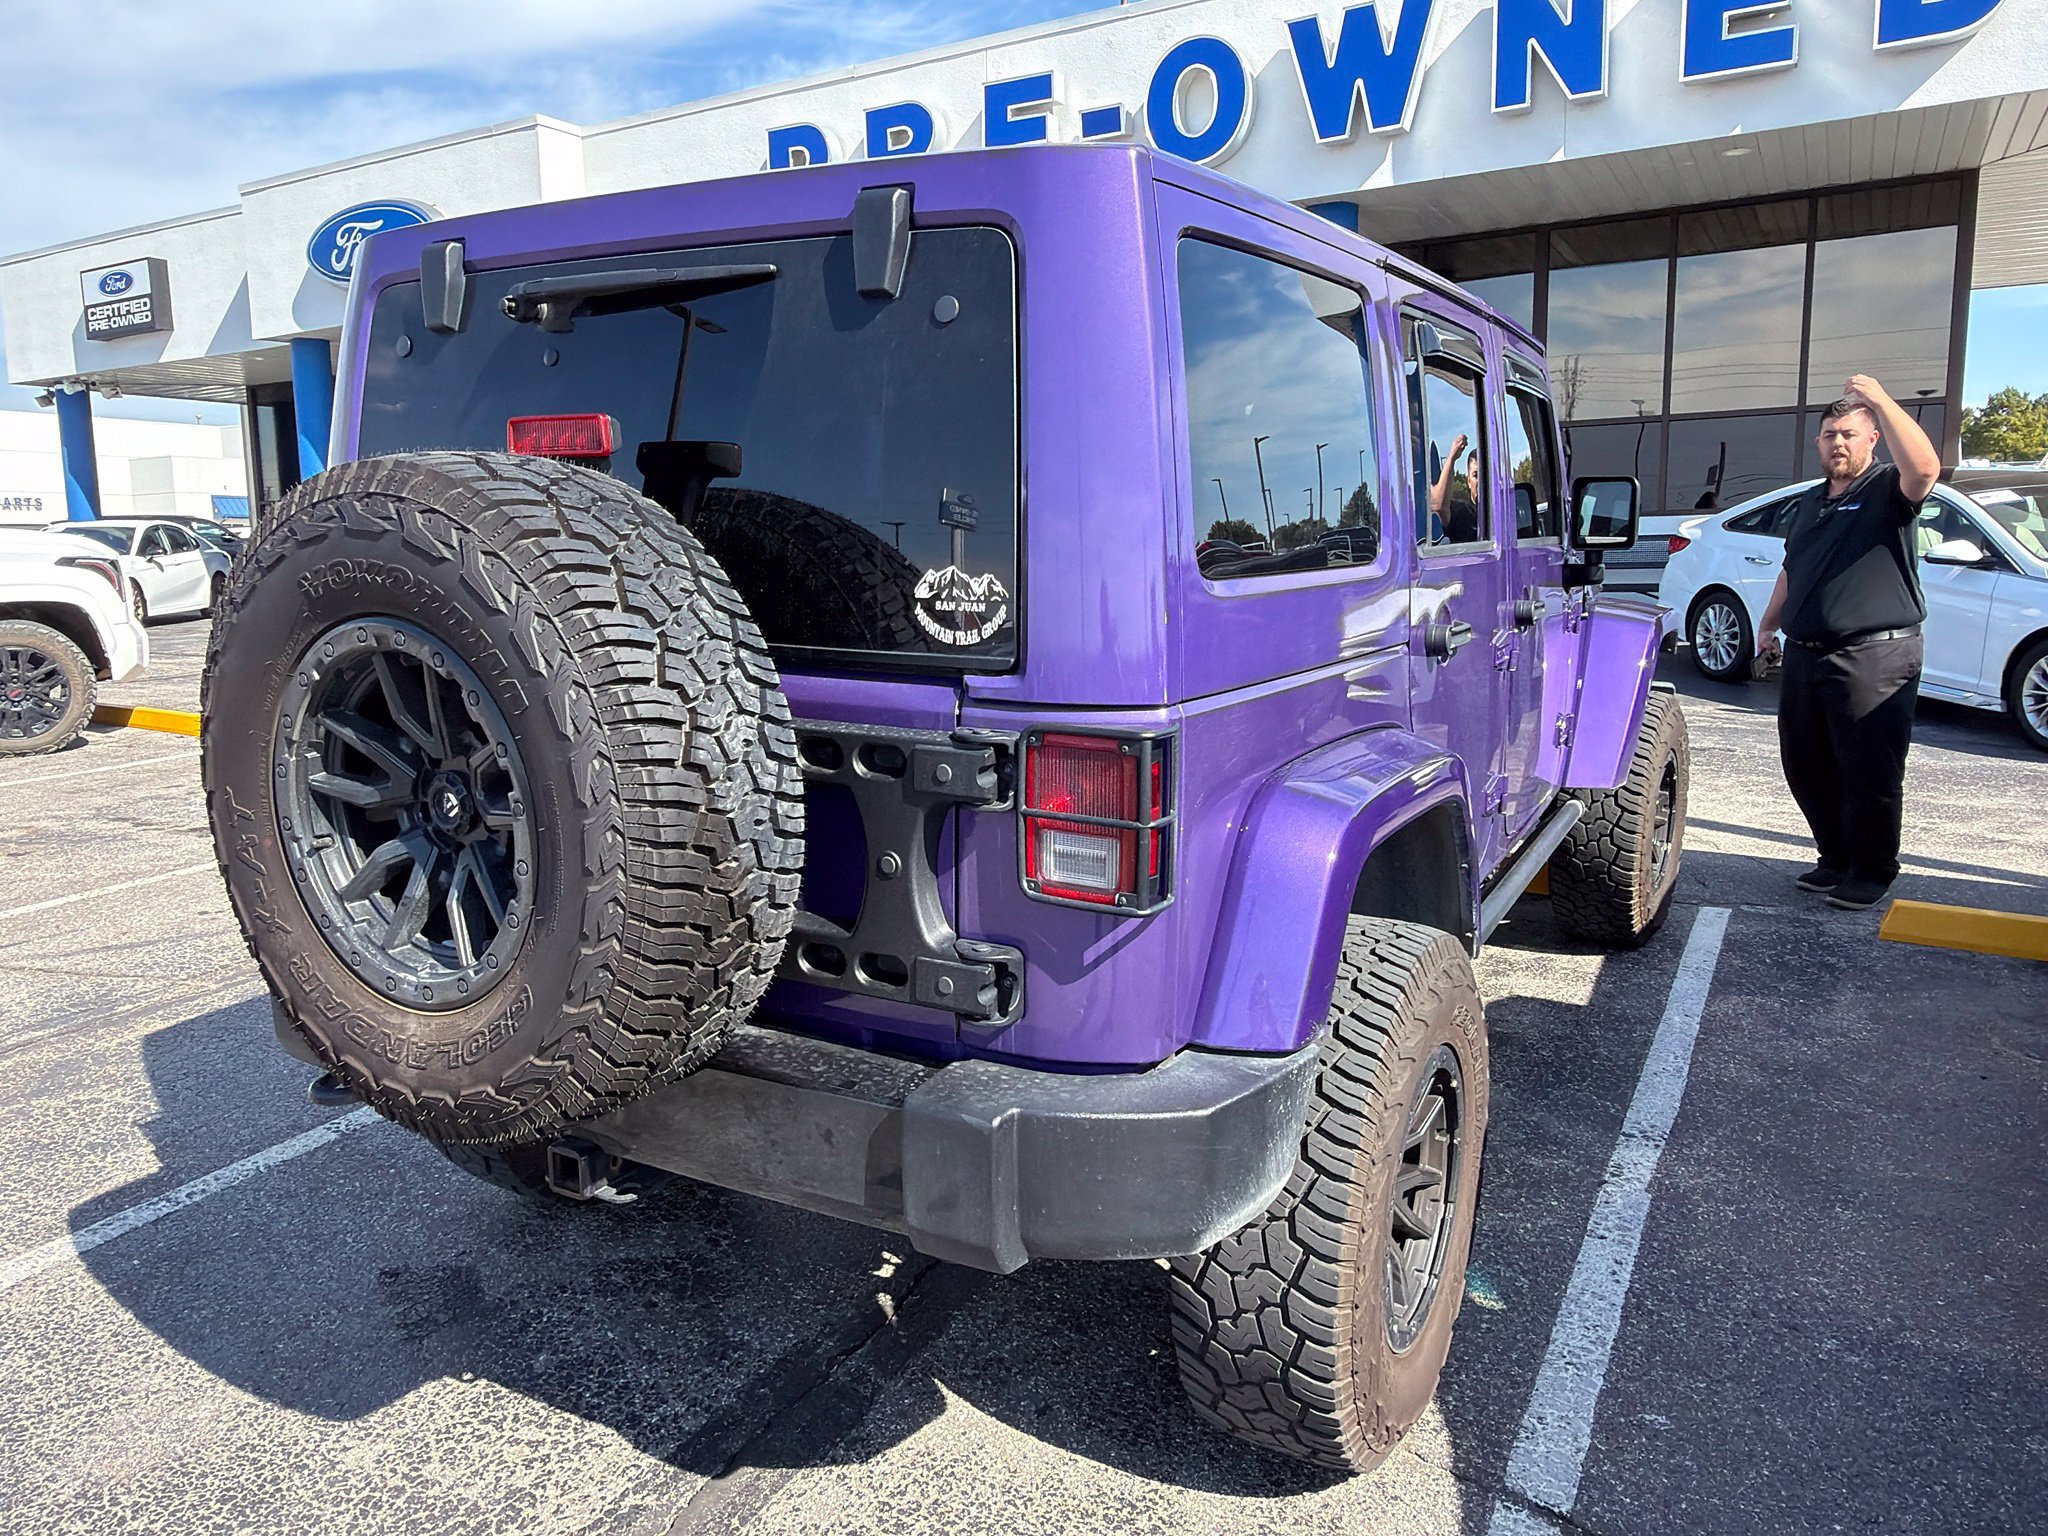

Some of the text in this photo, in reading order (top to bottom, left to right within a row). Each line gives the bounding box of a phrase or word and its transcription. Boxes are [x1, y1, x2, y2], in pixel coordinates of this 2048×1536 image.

[766, 0, 2006, 168] PRE-OWNE
[105, 275, 125, 291] Ford
[87, 297, 150, 320] CERTIFIED
[88, 311, 151, 332] PRE-OWNED
[935, 601, 986, 613] SAN JUAN
[914, 602, 1007, 646] MOUNTAIN TRAIL GROUP
